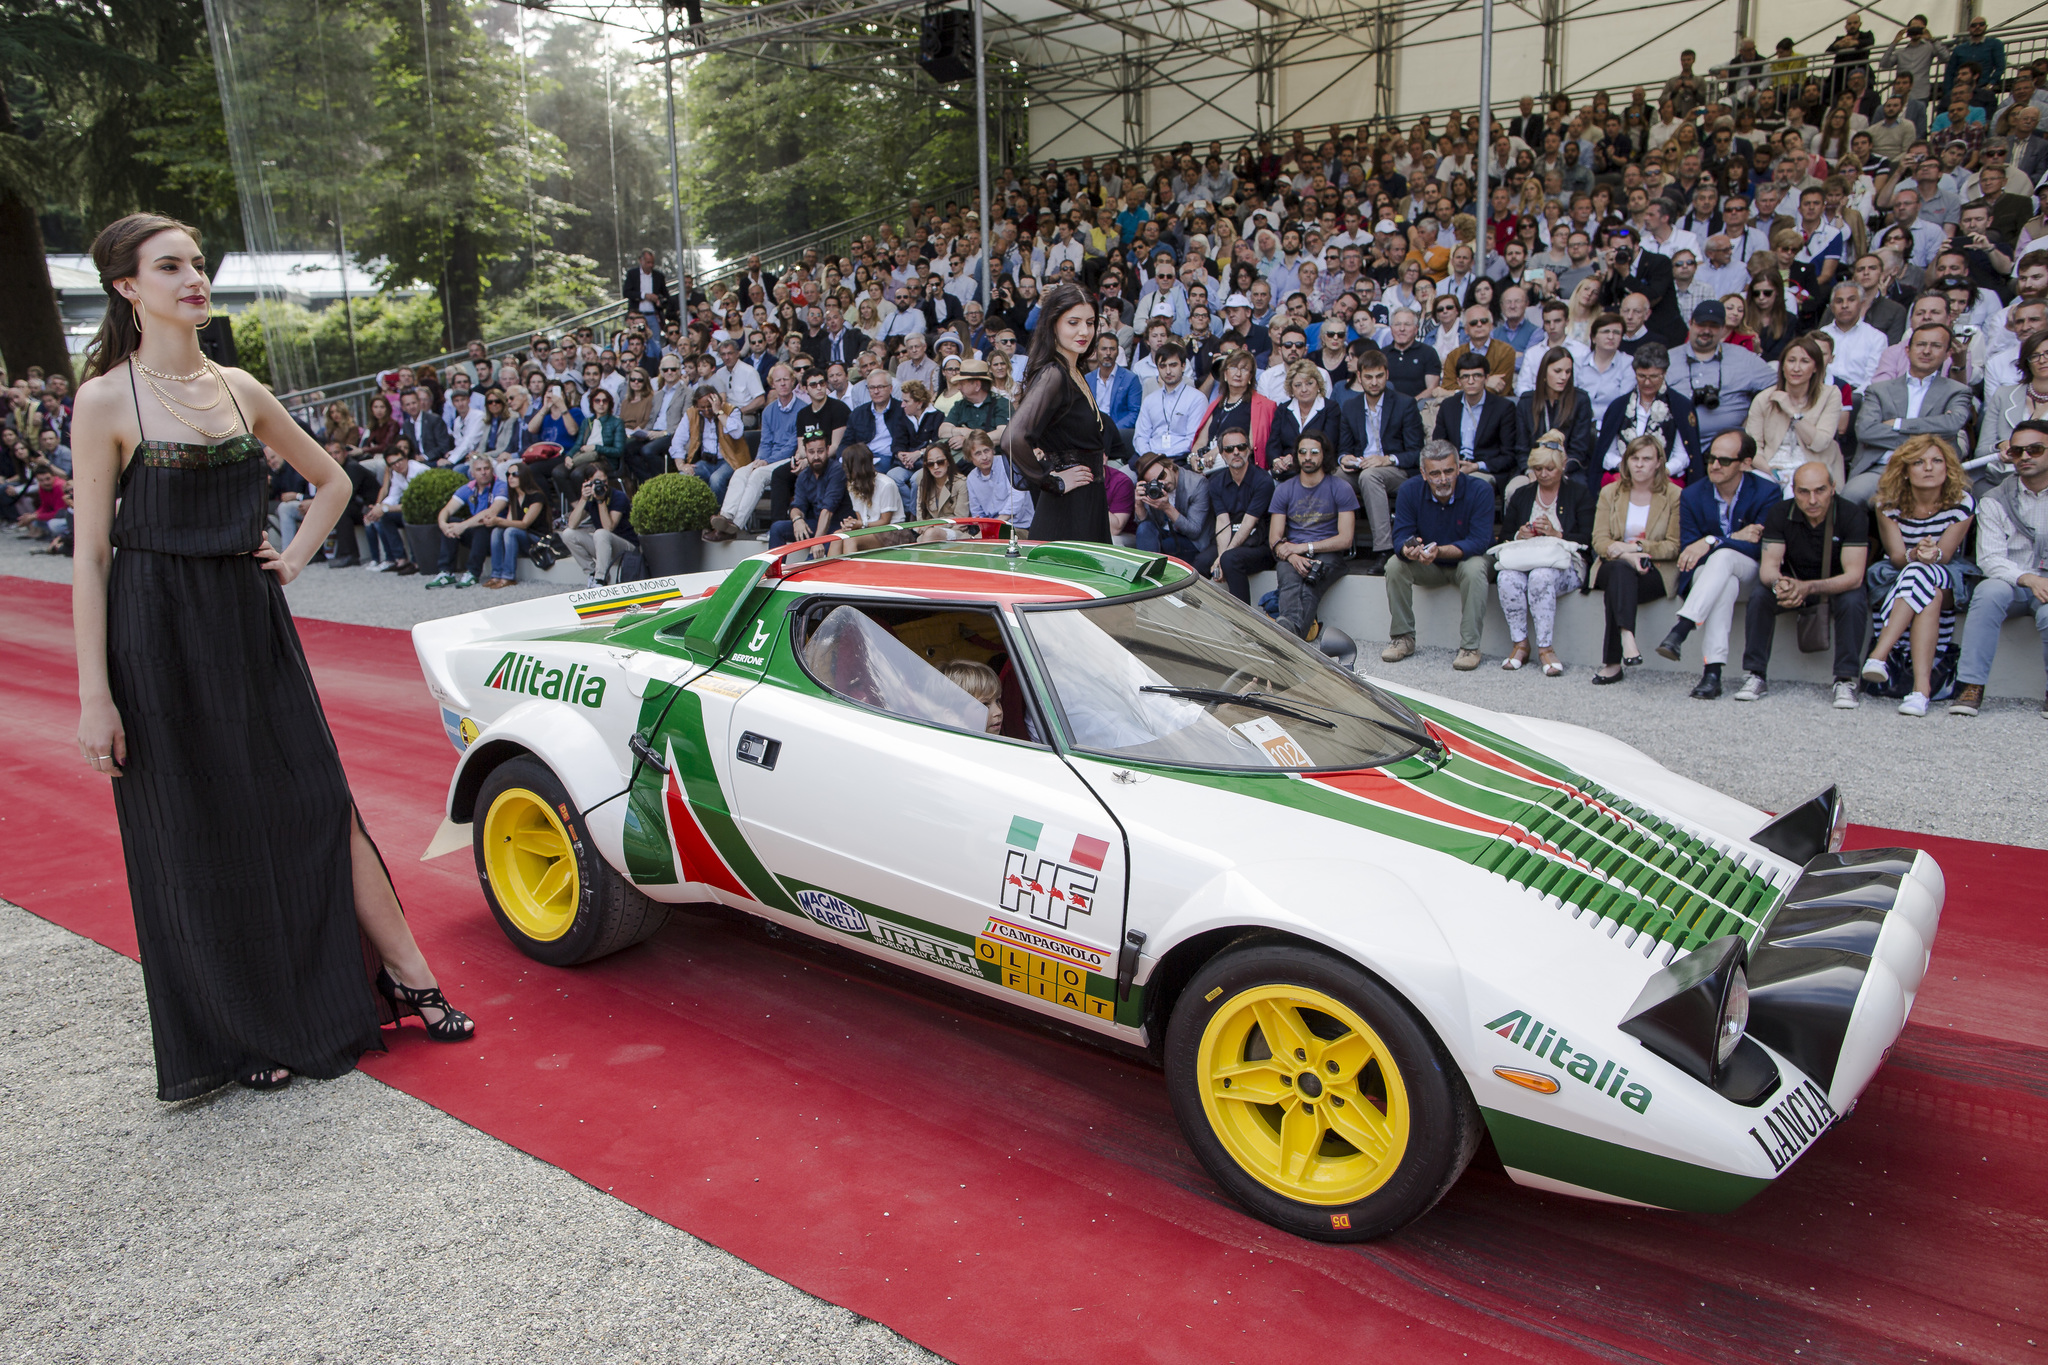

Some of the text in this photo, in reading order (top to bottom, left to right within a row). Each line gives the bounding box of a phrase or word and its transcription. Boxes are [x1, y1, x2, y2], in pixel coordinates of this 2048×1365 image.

[568, 578, 676, 603] CAMPIONE DEL MONDO
[484, 651, 607, 708] Alitalia
[731, 653, 764, 666] BERTONE
[1270, 742, 1307, 767] 102
[799, 892, 866, 922] MAGNETI
[999, 850, 1098, 930] HF
[801, 900, 866, 930] MARELLI
[864, 914, 979, 969] PIRELLI
[873, 936, 984, 977] WORLD RALLY CHAMPIONS
[999, 924, 1101, 965] CAMPAGNOLO
[980, 943, 1080, 985] OLIO
[1009, 974, 1108, 1014] FIAT
[1484, 1009, 1653, 1115] Alitalia
[1748, 1080, 1840, 1174] LANCIA
[1332, 1215, 1350, 1227] D5
